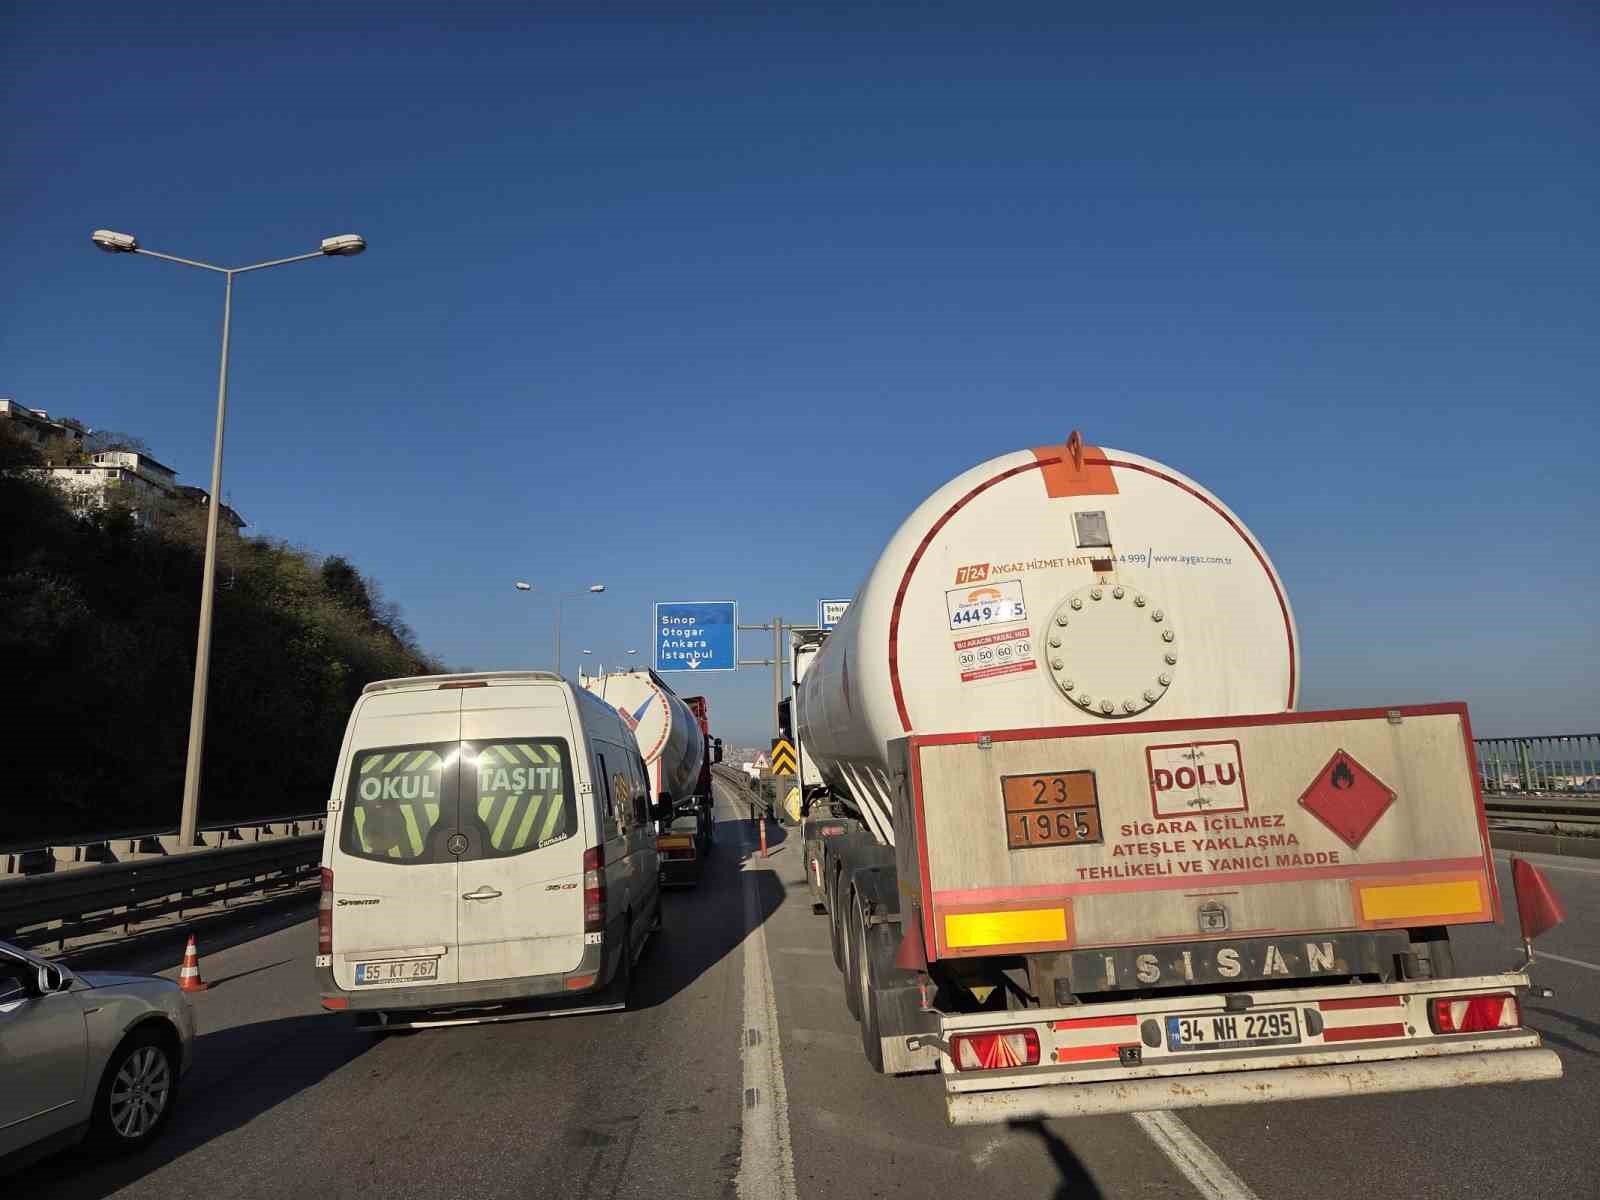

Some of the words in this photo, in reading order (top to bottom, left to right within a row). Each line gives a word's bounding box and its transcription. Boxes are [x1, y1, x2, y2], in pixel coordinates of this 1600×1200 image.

[991, 563, 1025, 576] AYGAZ
[1026, 557, 1064, 570] HİZMET
[1128, 553, 1146, 563] 999
[662, 616, 696, 626] Sinop
[662, 627, 705, 639] Otogar
[662, 639, 707, 648] Ankara
[961, 654, 974, 664] 30
[979, 650, 992, 660] 50
[998, 647, 1011, 656] 60
[1016, 643, 1030, 653] 70
[360, 775, 435, 801] OKUL
[479, 767, 559, 795] TAŞITI
[1153, 763, 1237, 792] DOLU
[1032, 778, 1067, 804] 23
[1019, 811, 1091, 841] 1965
[1121, 819, 1197, 837] SİGARA
[1204, 814, 1286, 832] İÇİLMEZ
[1112, 840, 1186, 858] ATEŞLE
[1192, 832, 1299, 853] YAKLAŞMA
[1076, 859, 1173, 881] TEHLİKELİ
[1178, 859, 1203, 874] VE
[1210, 853, 1269, 872] YANICI
[1275, 850, 1340, 867] MADDE
[366, 965, 381, 979] 55
[389, 963, 405, 978] KT
[412, 961, 434, 976] 267
[1104, 942, 1336, 986] ISISAN
[1179, 1019, 1204, 1042] 34
[1212, 1017, 1238, 1040] NH
[1244, 1013, 1293, 1038] 2295
